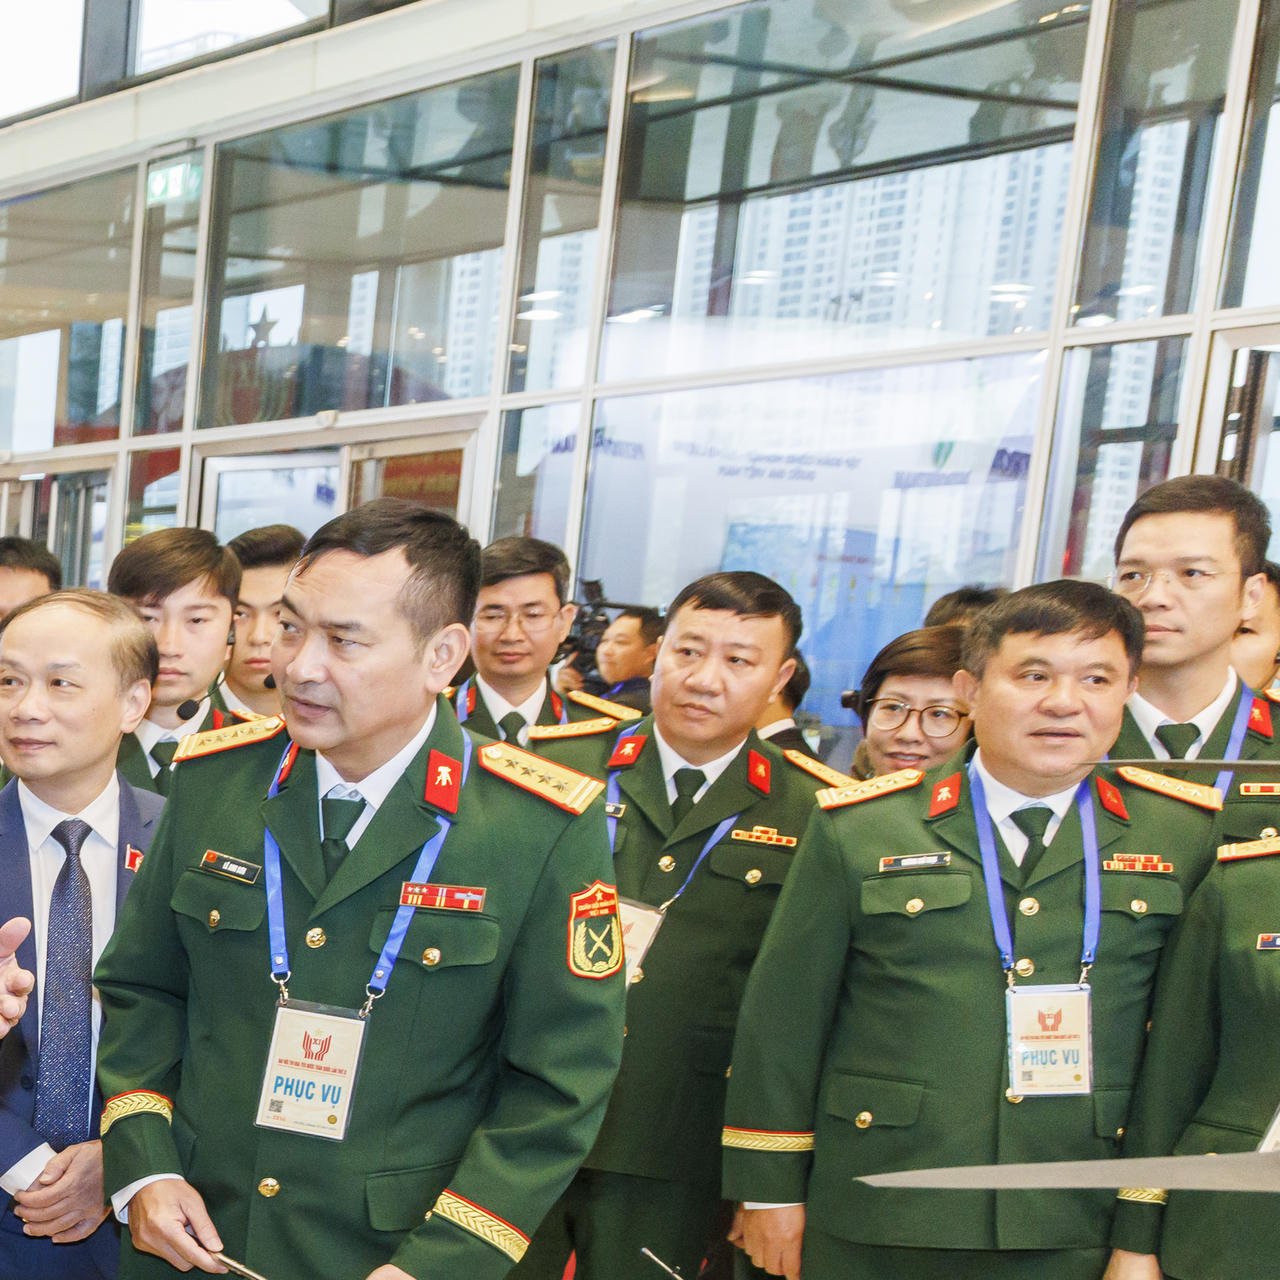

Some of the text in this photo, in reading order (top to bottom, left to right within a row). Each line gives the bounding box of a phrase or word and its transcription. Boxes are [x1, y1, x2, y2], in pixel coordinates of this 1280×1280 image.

[1021, 1049, 1080, 1069] PHỤC VỤ
[273, 1075, 342, 1109] PHỤC VỤ
